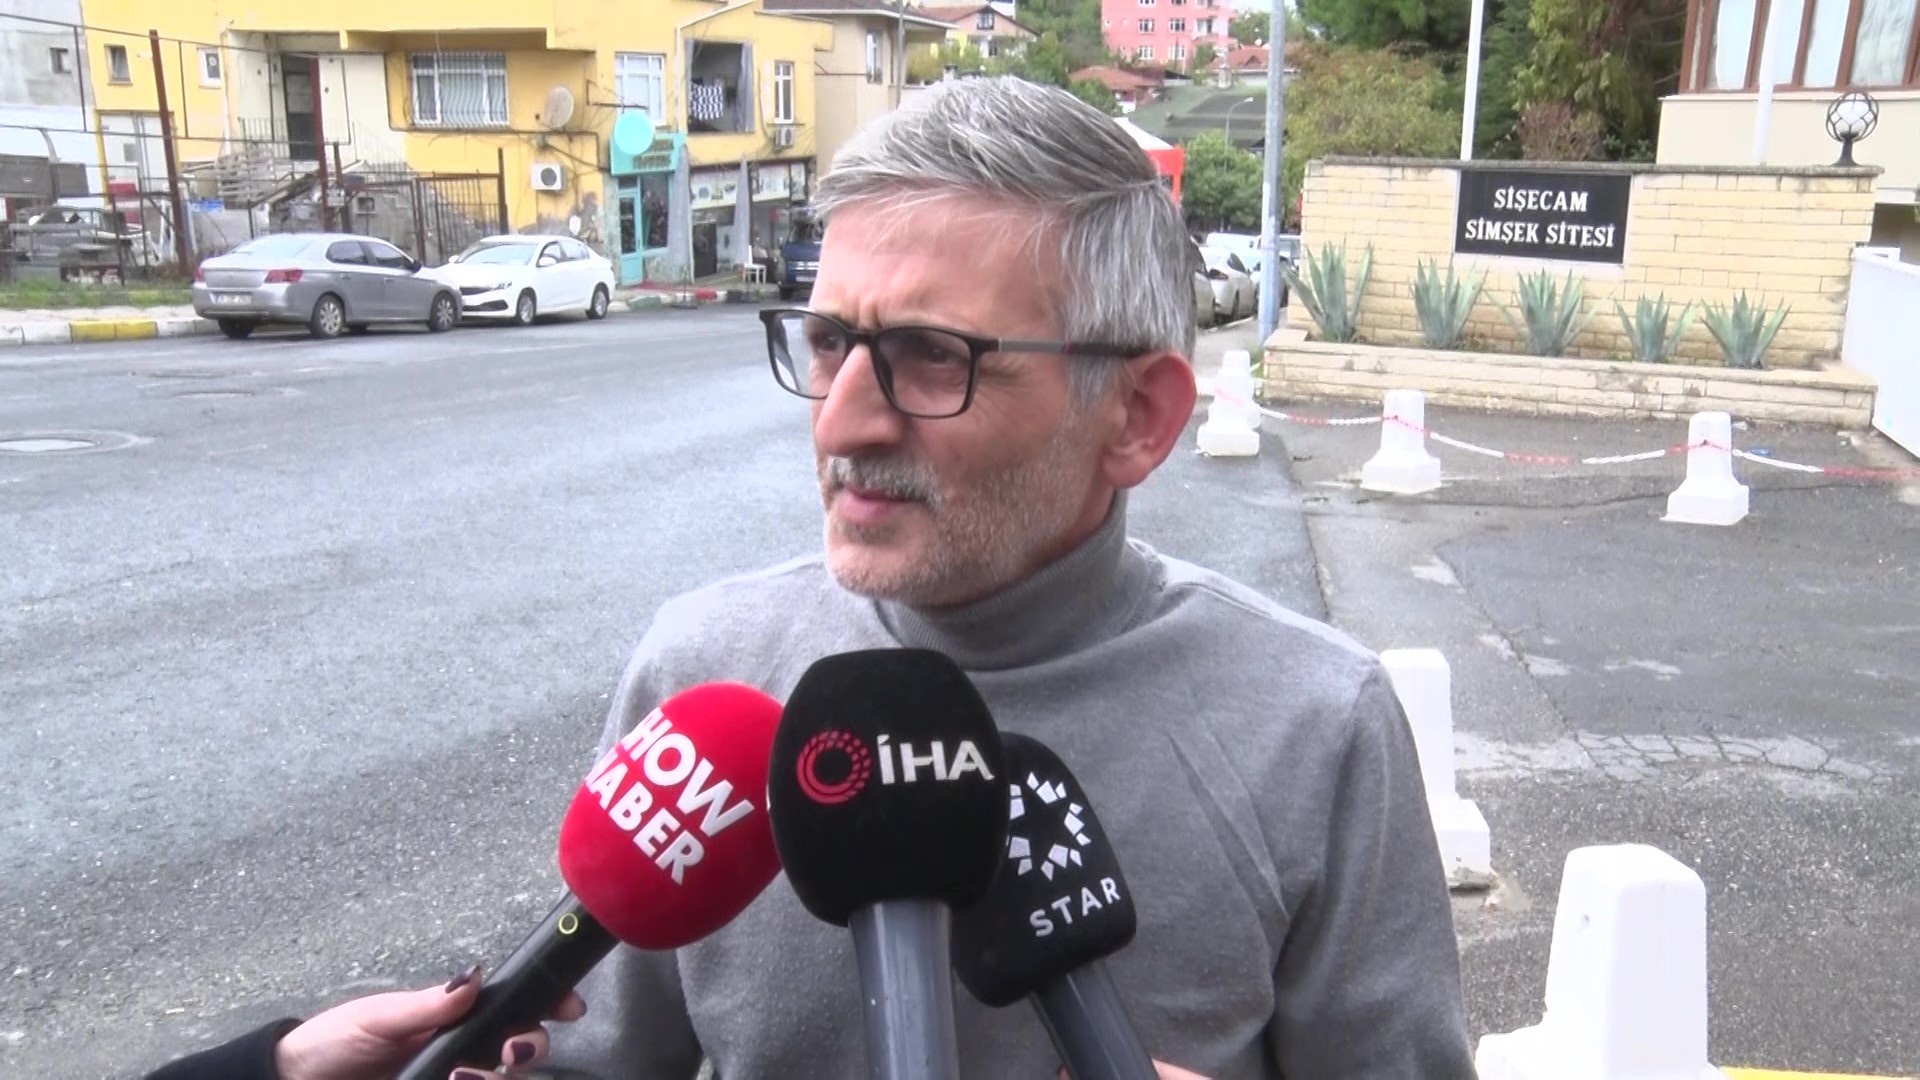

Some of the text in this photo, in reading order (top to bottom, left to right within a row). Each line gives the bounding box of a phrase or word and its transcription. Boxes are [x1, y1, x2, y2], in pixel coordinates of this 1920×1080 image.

[1494, 185, 1589, 212] SİŞECAM
[1465, 217, 1616, 248] SİMŞEK SİTESİ
[619, 706, 756, 838] HOW
[877, 734, 995, 785] İHA
[1029, 877, 1121, 937] STAR
